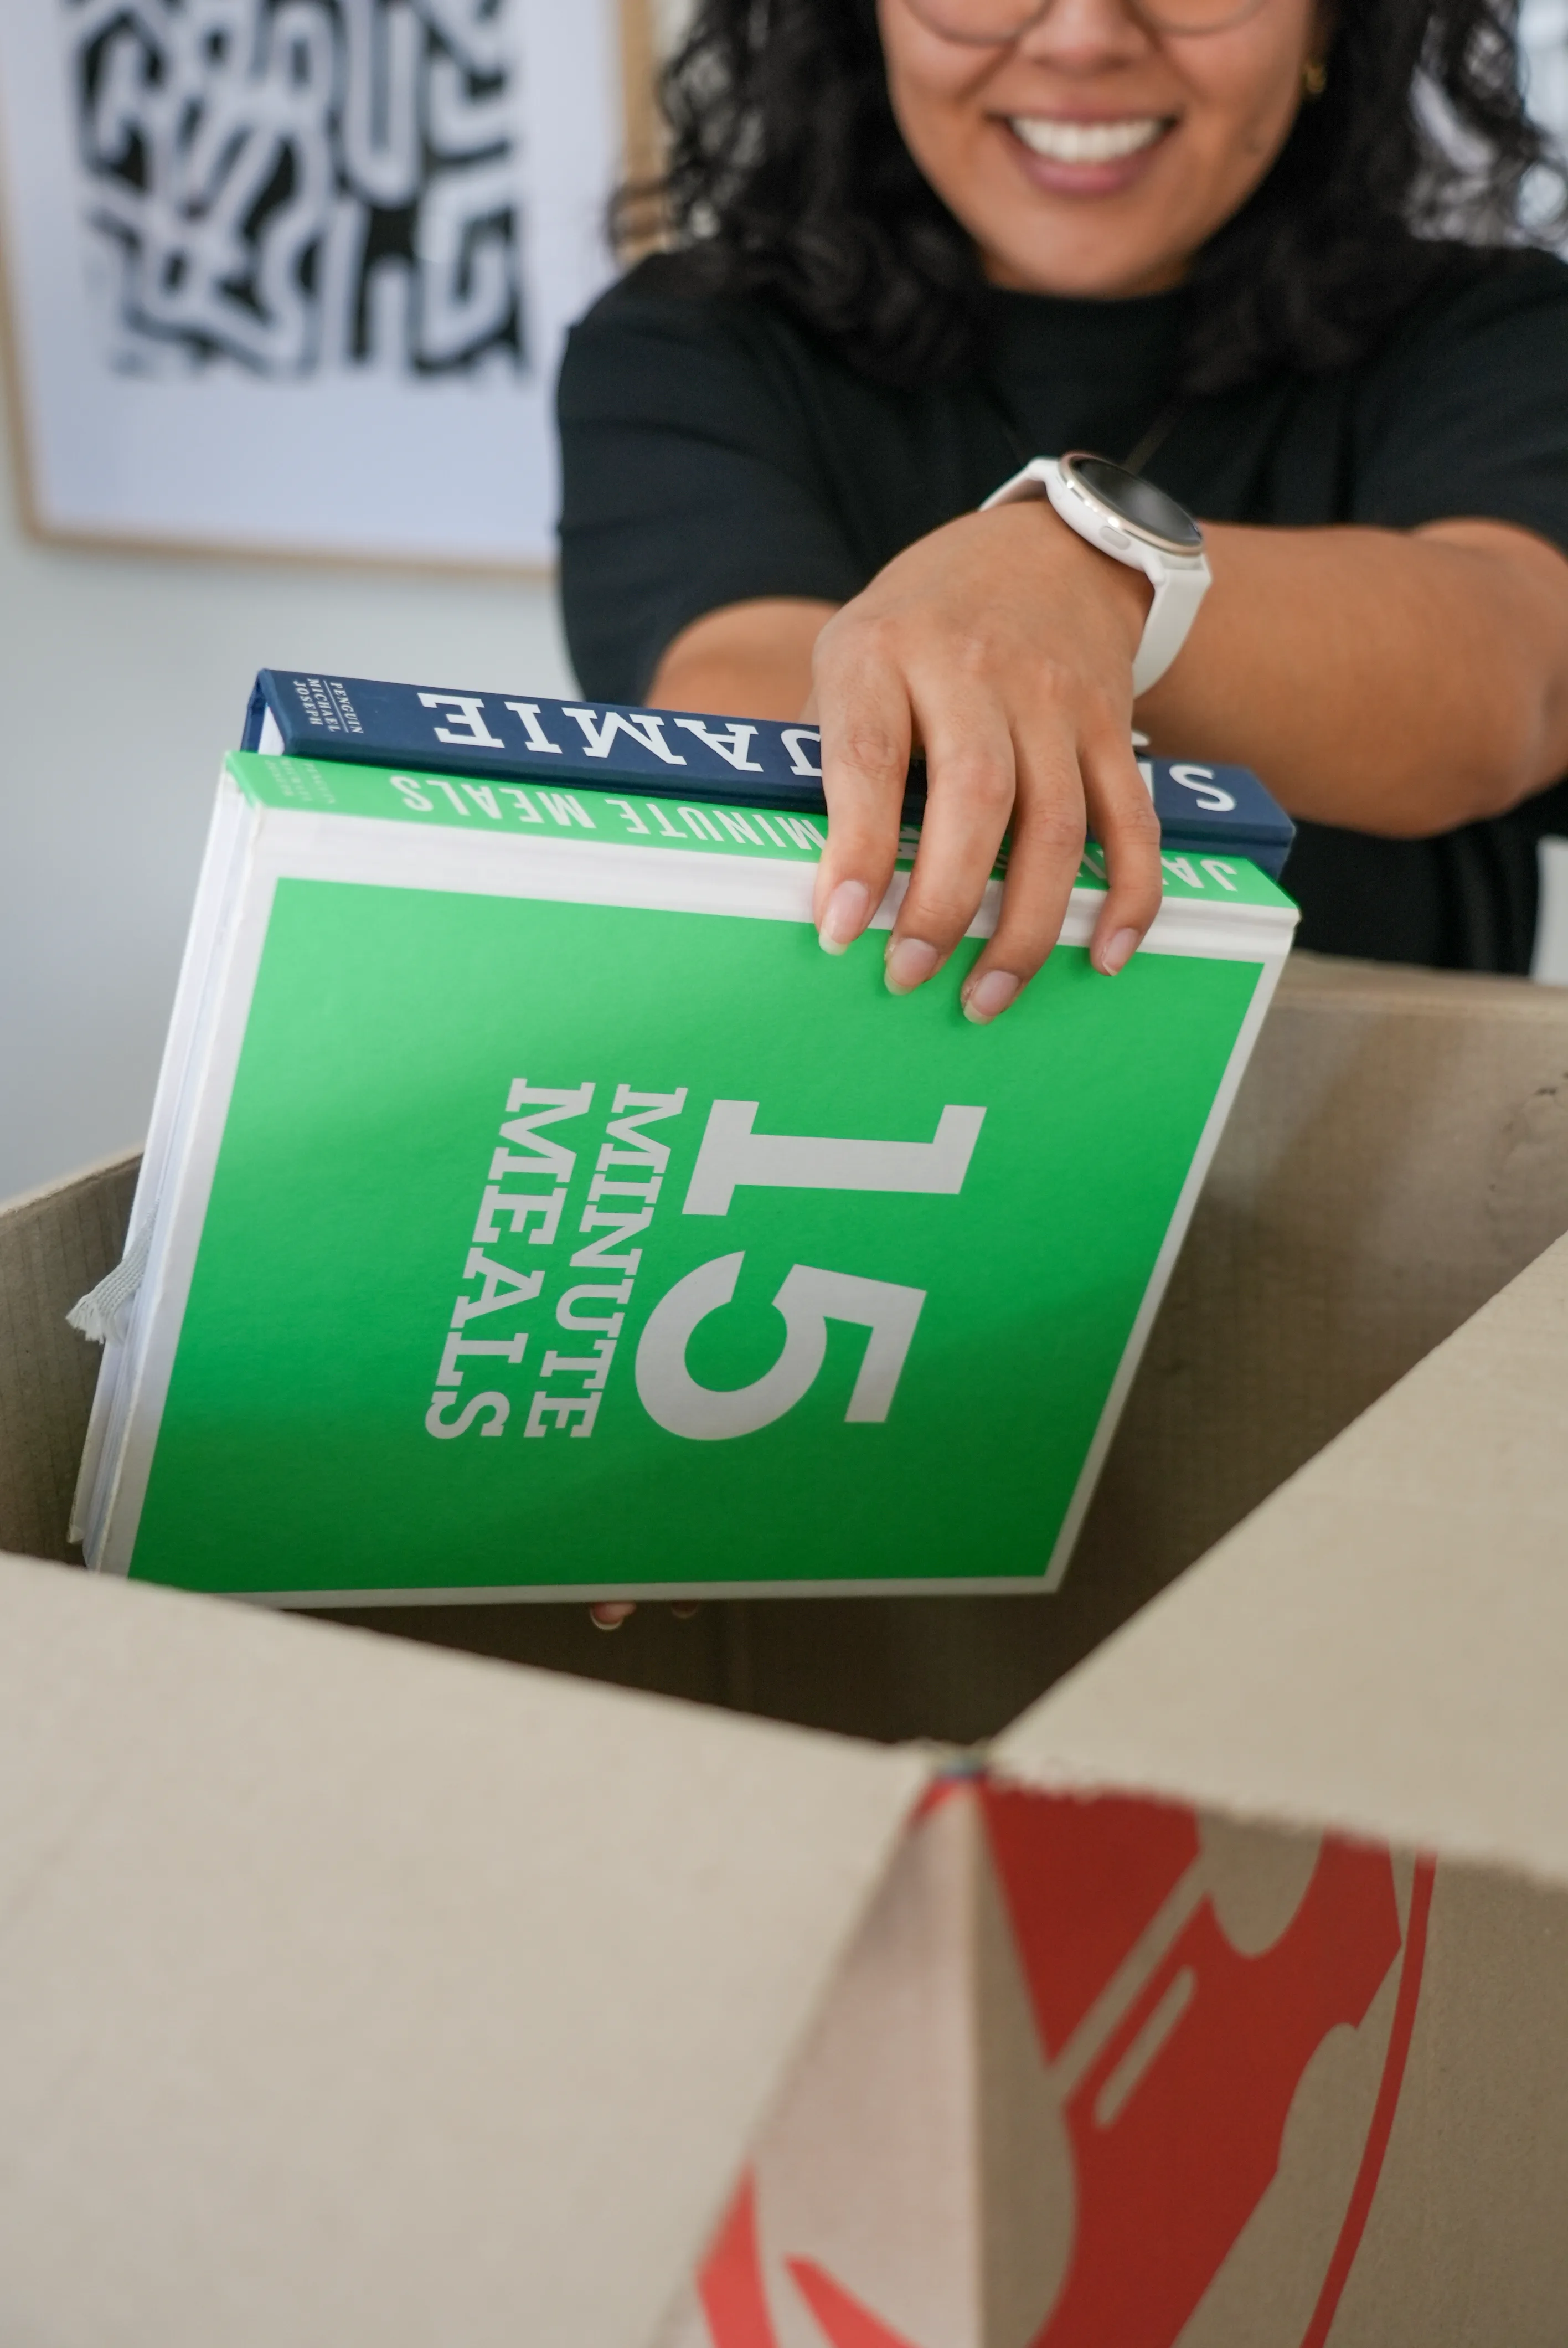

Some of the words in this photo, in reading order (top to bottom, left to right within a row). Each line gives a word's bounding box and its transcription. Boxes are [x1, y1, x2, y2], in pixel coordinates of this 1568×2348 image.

[293, 680, 323, 726] JOSEPH
[307, 678, 341, 733] MICHAEL
[329, 682, 364, 734] PENGUIN
[416, 692, 822, 778] JAMIE
[390, 776, 596, 828] MEALS
[605, 799, 826, 850] MINUTE
[425, 1077, 596, 1440] MEALS
[524, 1083, 689, 1438] MINUTE
[635, 1099, 988, 1440] 15
